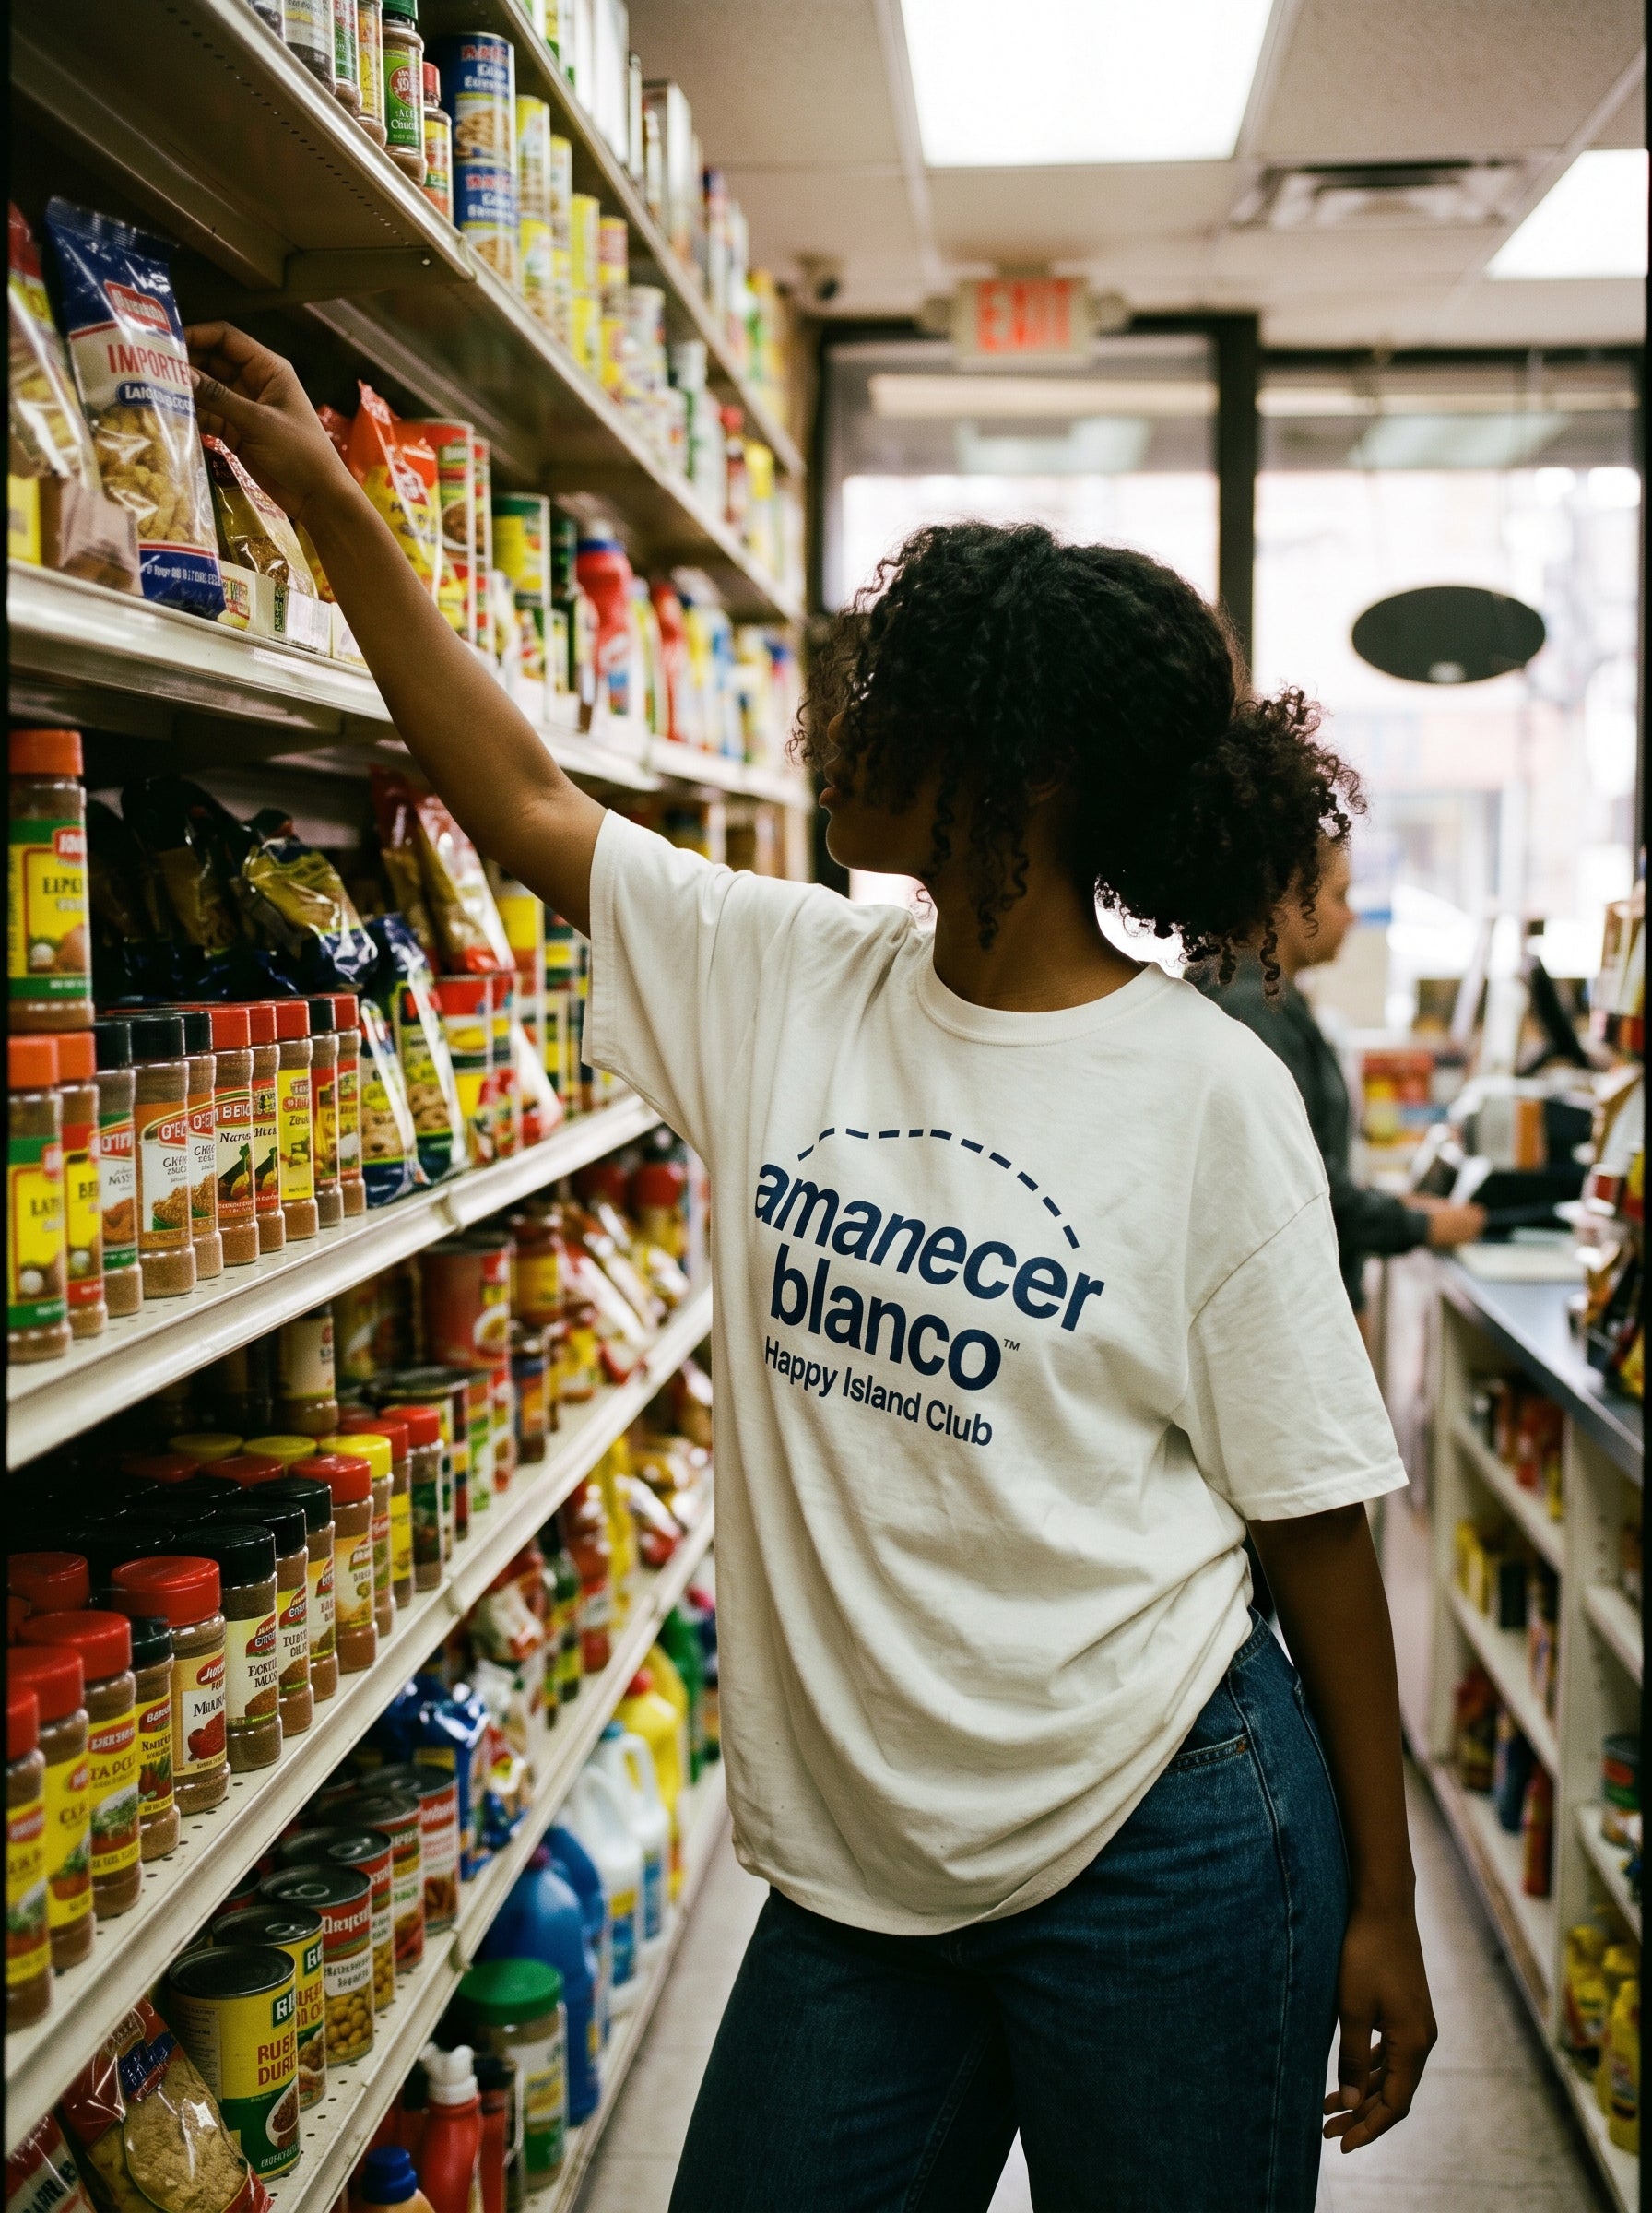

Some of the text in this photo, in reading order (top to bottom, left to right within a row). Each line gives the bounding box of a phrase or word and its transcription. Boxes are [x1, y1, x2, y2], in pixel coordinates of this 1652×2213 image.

[755, 1163, 1105, 1332] amanecer
[770, 1243, 1002, 1391] blanco
[764, 1336, 993, 1447] Happy Island Club
